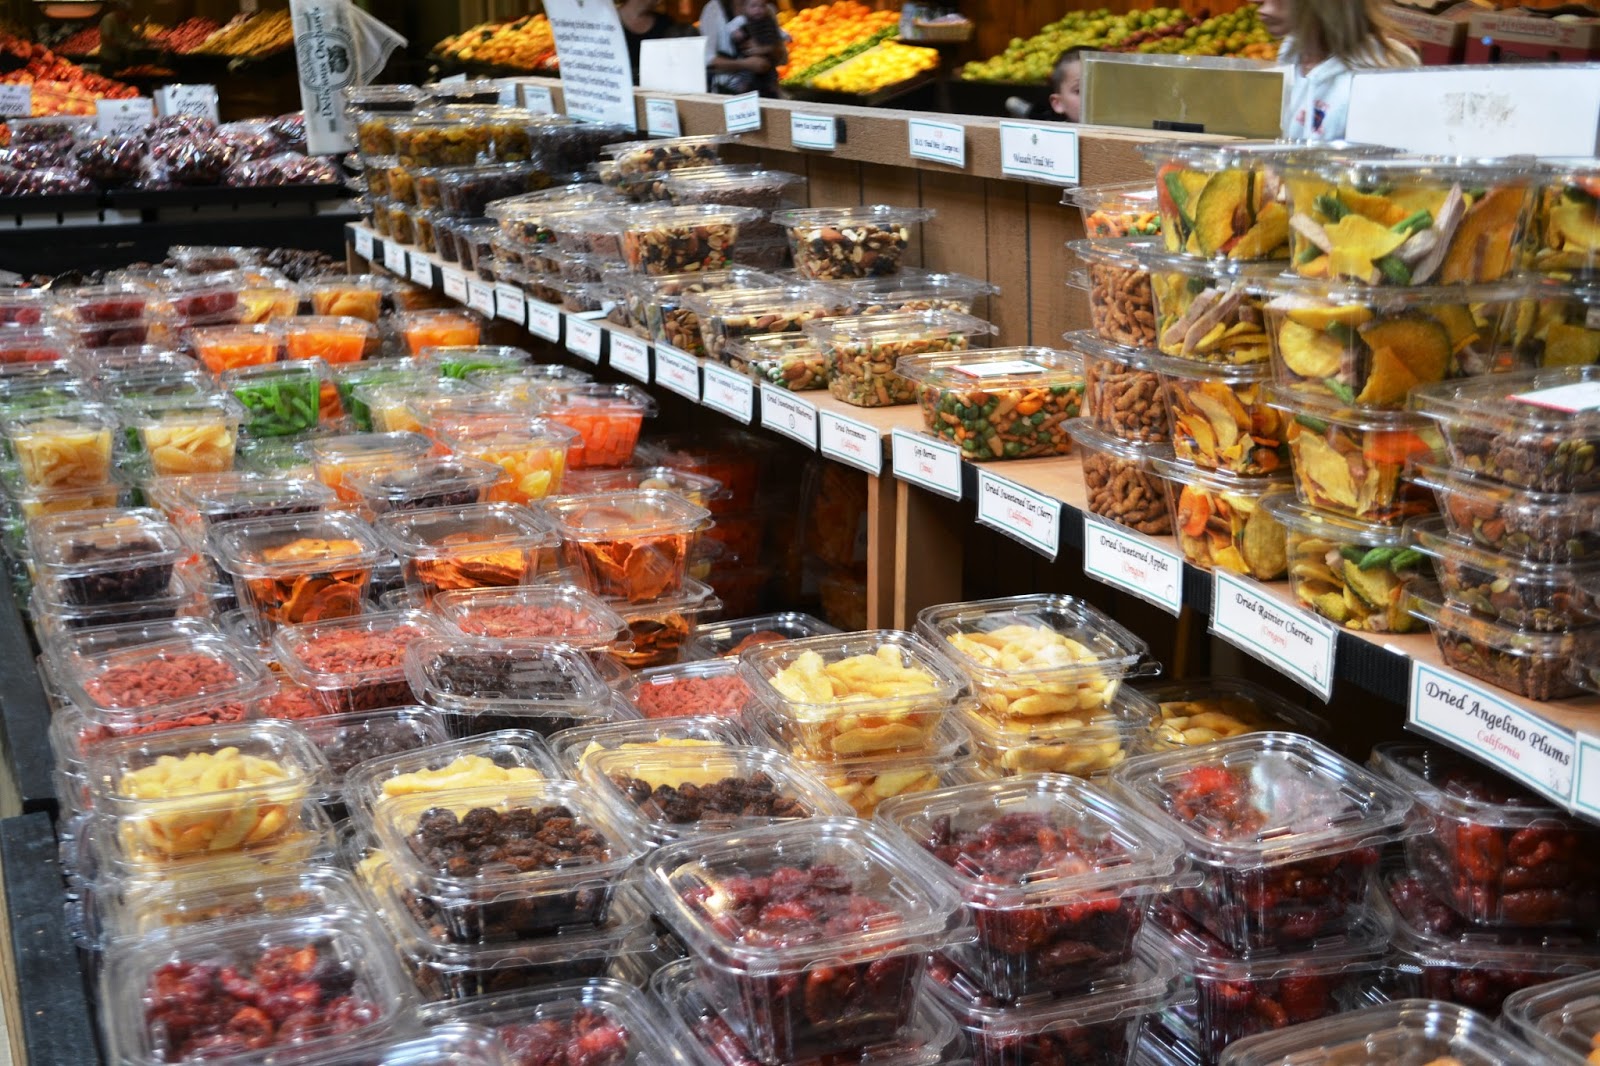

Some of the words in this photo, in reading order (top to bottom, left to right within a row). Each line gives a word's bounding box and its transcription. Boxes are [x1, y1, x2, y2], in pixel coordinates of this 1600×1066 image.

[1032, 154, 1044, 166] Trail
[766, 393, 777, 405] Dried
[835, 422, 845, 433] Dried
[985, 482, 1000, 496] Dried
[1000, 488, 1027, 507] Sweetened
[1025, 500, 1036, 513] Tart
[1036, 505, 1053, 524] Cherry
[1099, 535, 1118, 550] Dried
[1117, 542, 1149, 563] Sweetened
[1148, 554, 1169, 572] Apples
[1235, 592, 1257, 612] Dried
[1257, 604, 1285, 627] Rainier
[1285, 619, 1315, 646] Cherries
[1425, 681, 1469, 711] Dried
[1465, 701, 1527, 742] Angelino
[1529, 732, 1571, 767] Plums
[1476, 730, 1521, 761] California
